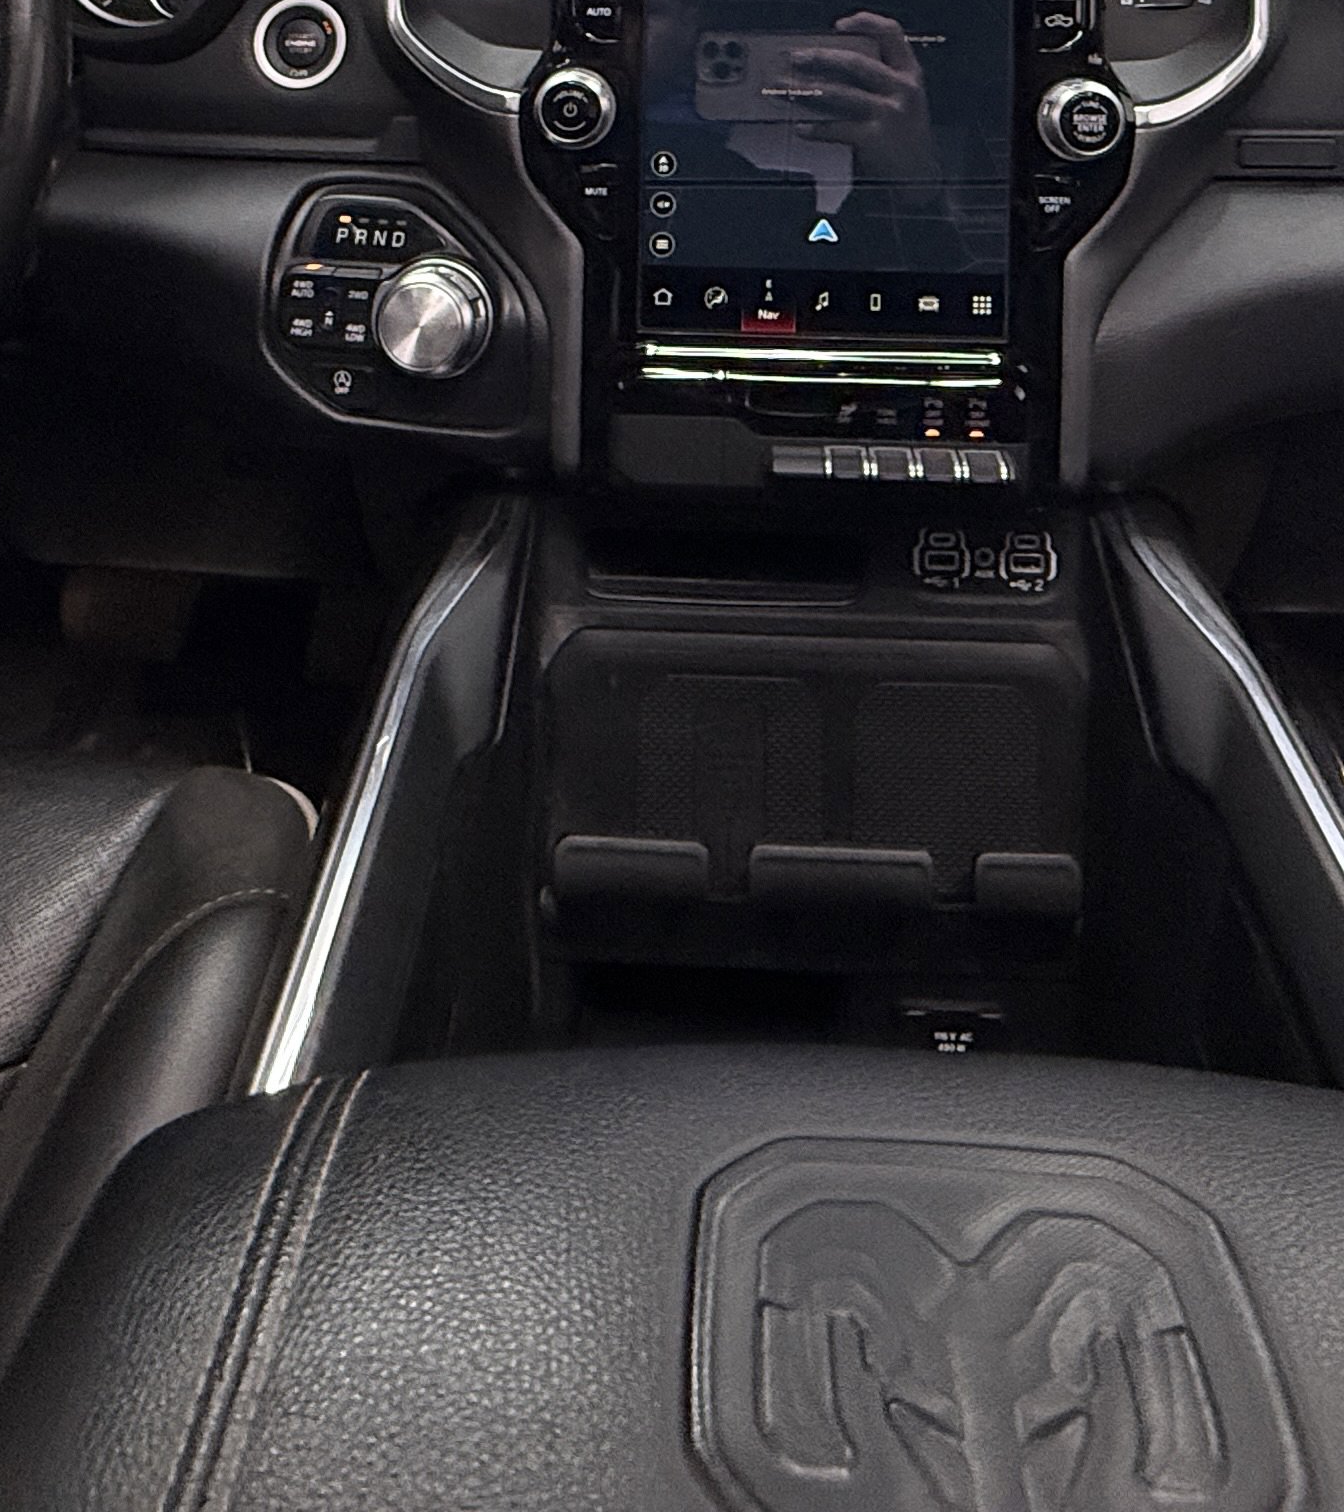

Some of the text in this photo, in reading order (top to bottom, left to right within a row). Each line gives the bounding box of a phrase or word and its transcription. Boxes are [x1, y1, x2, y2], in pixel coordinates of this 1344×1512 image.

[586, 7, 612, 17] AUTO
[1072, 113, 1107, 123] BROWSE
[1077, 125, 1104, 133] ENTER
[584, 187, 608, 196] MUTE
[1038, 196, 1071, 205] SCREEN
[1044, 205, 1060, 213] OFF
[336, 228, 406, 248] P R N D
[290, 288, 315, 299] AUTO
[347, 290, 369, 300] 2WD
[758, 308, 780, 320] Nav
[344, 333, 365, 343] LOW
[1033, 579, 1044, 592] 2
